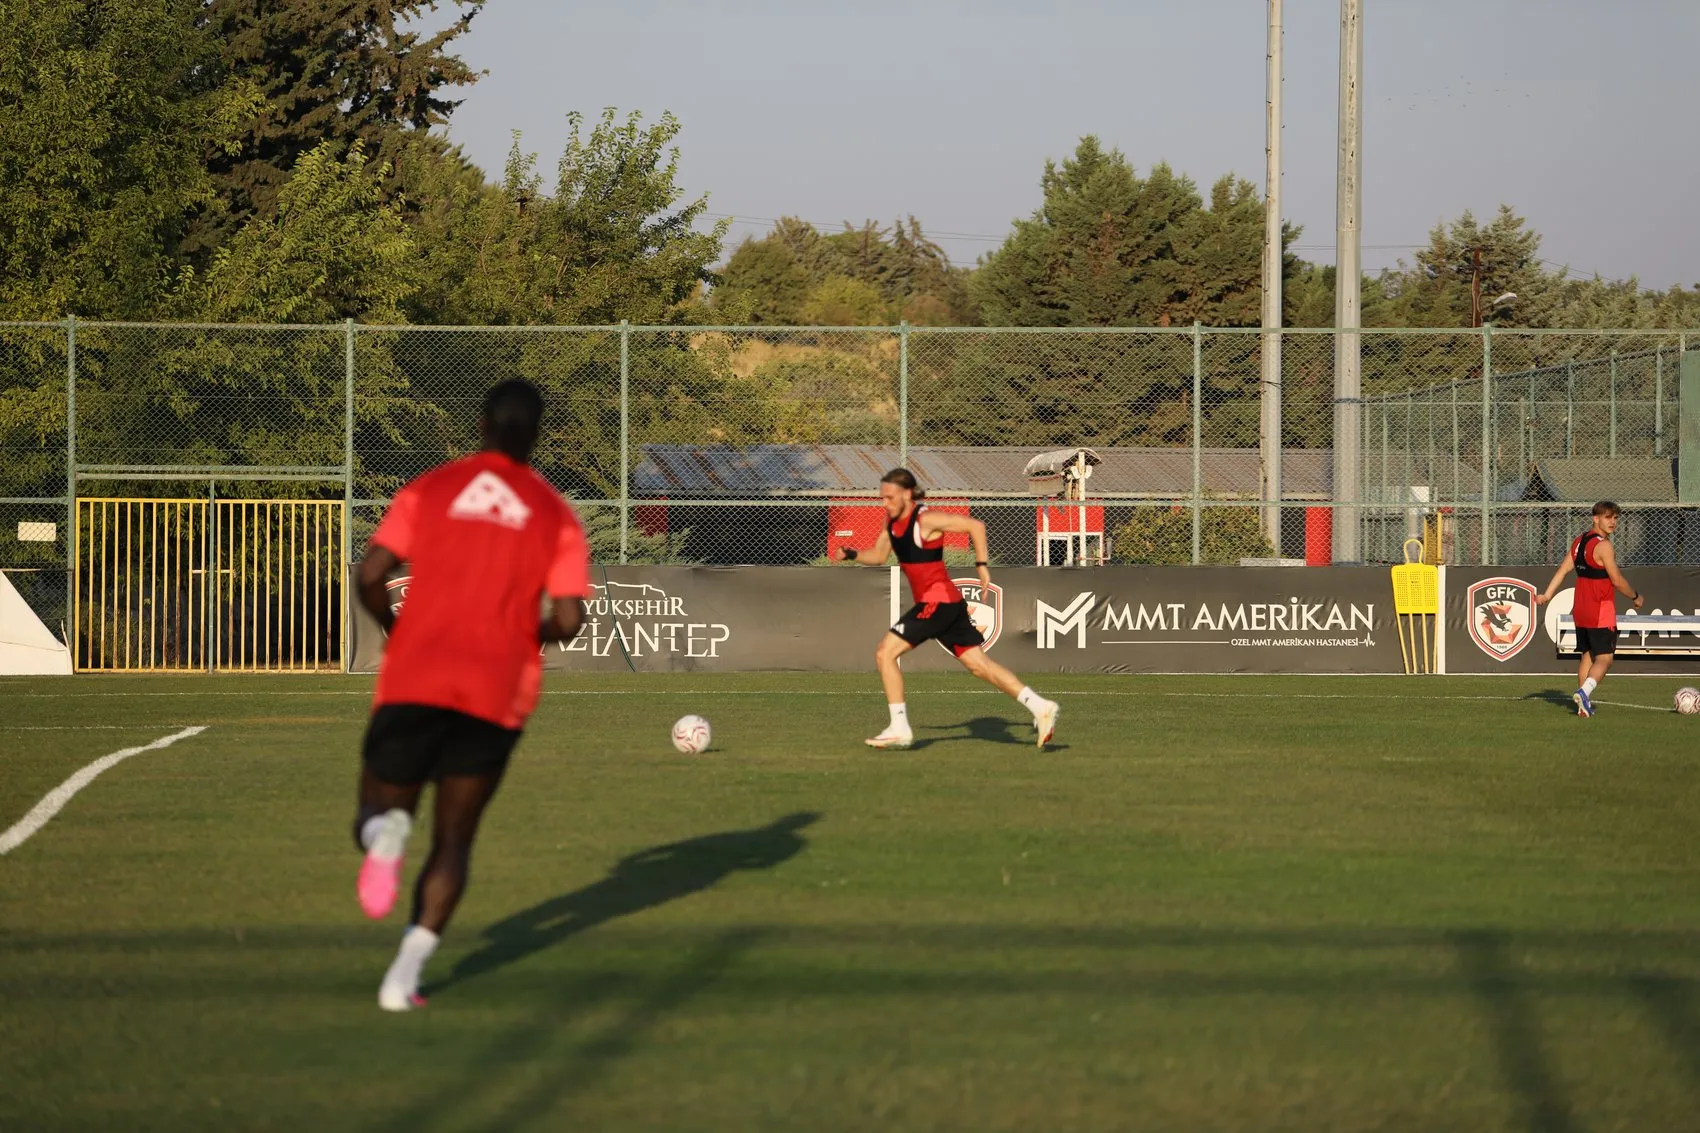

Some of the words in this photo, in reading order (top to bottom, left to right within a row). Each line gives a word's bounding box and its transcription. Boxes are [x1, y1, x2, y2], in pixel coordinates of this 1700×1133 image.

[961, 588, 982, 600] FK
[1486, 587, 1517, 600] GFK
[582, 597, 688, 619] YÜKŞEHİR
[1102, 602, 1185, 630] MMT
[1191, 596, 1374, 631] AMERİKAN
[541, 618, 730, 657] ZİANTEP
[1252, 638, 1271, 647] MMT
[1272, 637, 1315, 647] AMERİKAN
[1316, 637, 1358, 647] HASTANESİ
